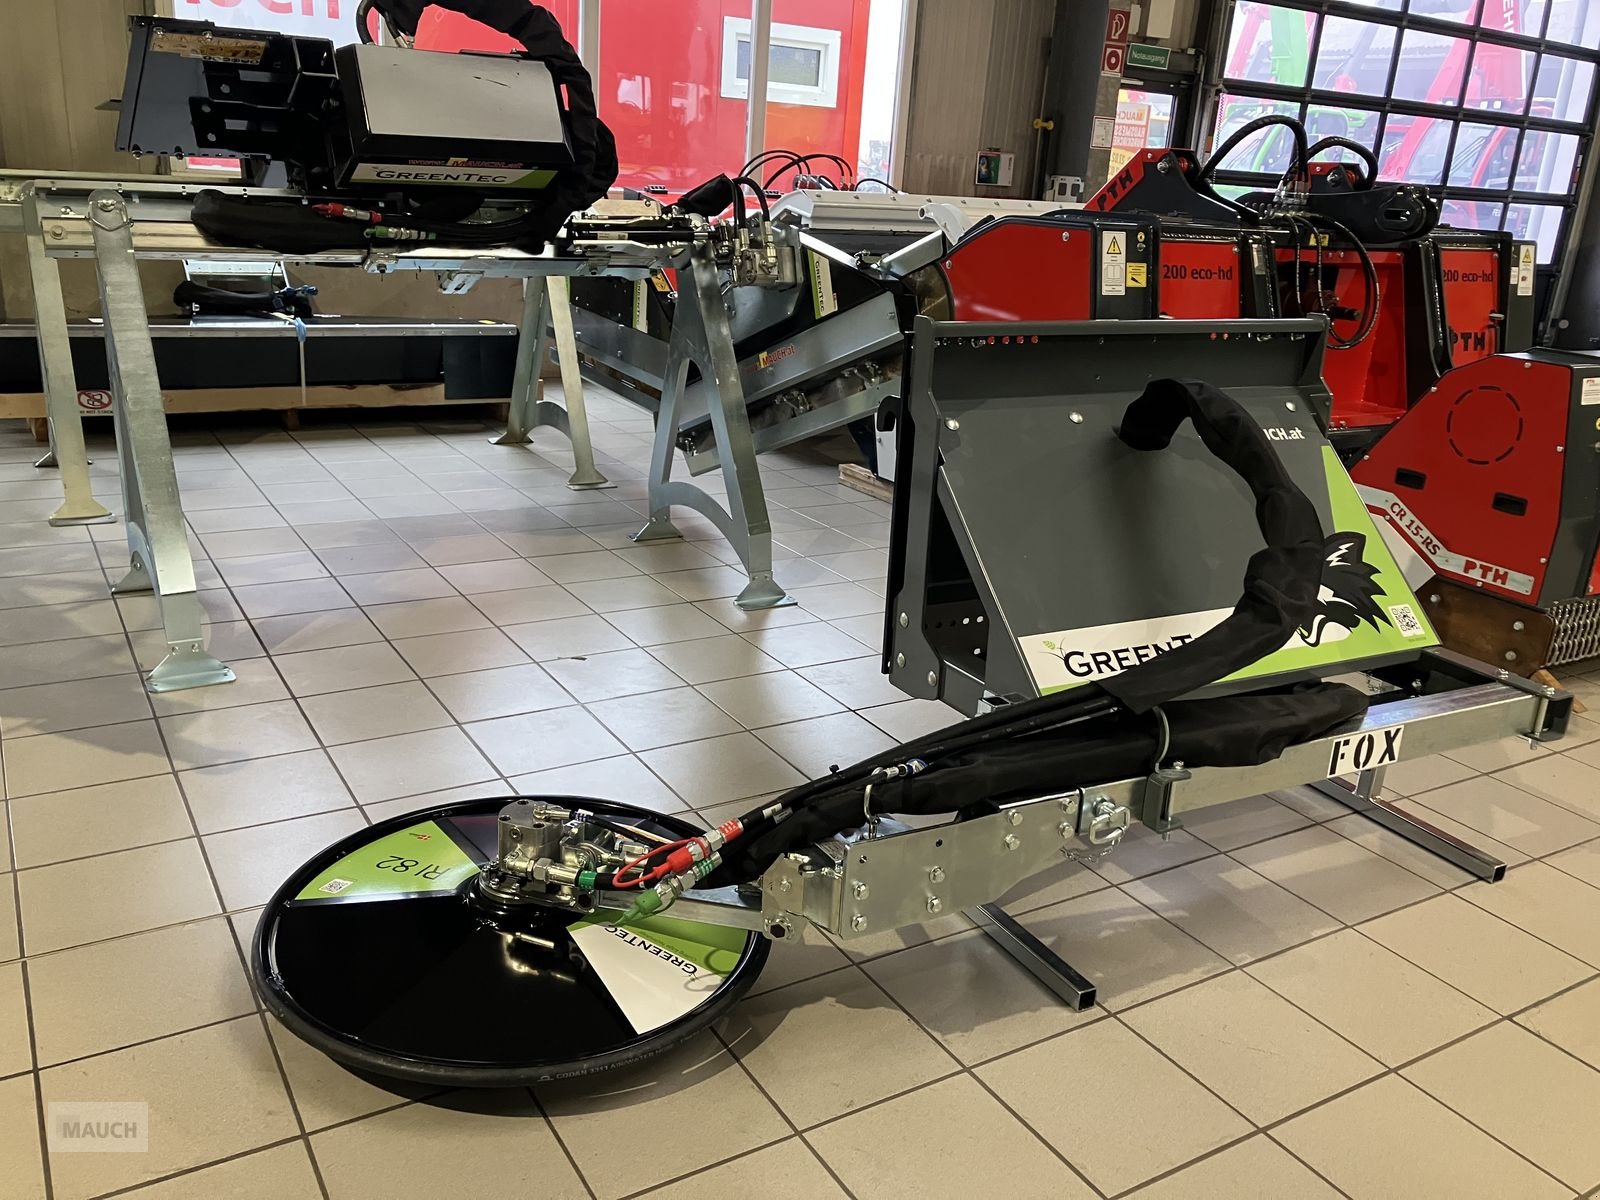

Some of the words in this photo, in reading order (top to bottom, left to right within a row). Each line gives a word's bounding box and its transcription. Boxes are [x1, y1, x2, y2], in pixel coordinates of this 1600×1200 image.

[1131, 50, 1166, 64] Notausgang
[375, 170, 508, 183] GREENTEC
[1096, 169, 1133, 211] PTH
[1162, 265, 1187, 279] 200
[1190, 265, 1233, 281] eco-hd
[1442, 270, 1459, 282] 200
[1461, 270, 1494, 283] eco-hd
[814, 259, 825, 313] GREENTEC
[1449, 331, 1486, 353] PTH
[1390, 502, 1407, 521] CR
[1405, 519, 1441, 556] 15-RS
[1463, 559, 1509, 585] PTH
[1329, 728, 1402, 775] FOX
[376, 855, 419, 873] 82
[414, 864, 450, 880] RI
[604, 926, 698, 975] GREENTEC
